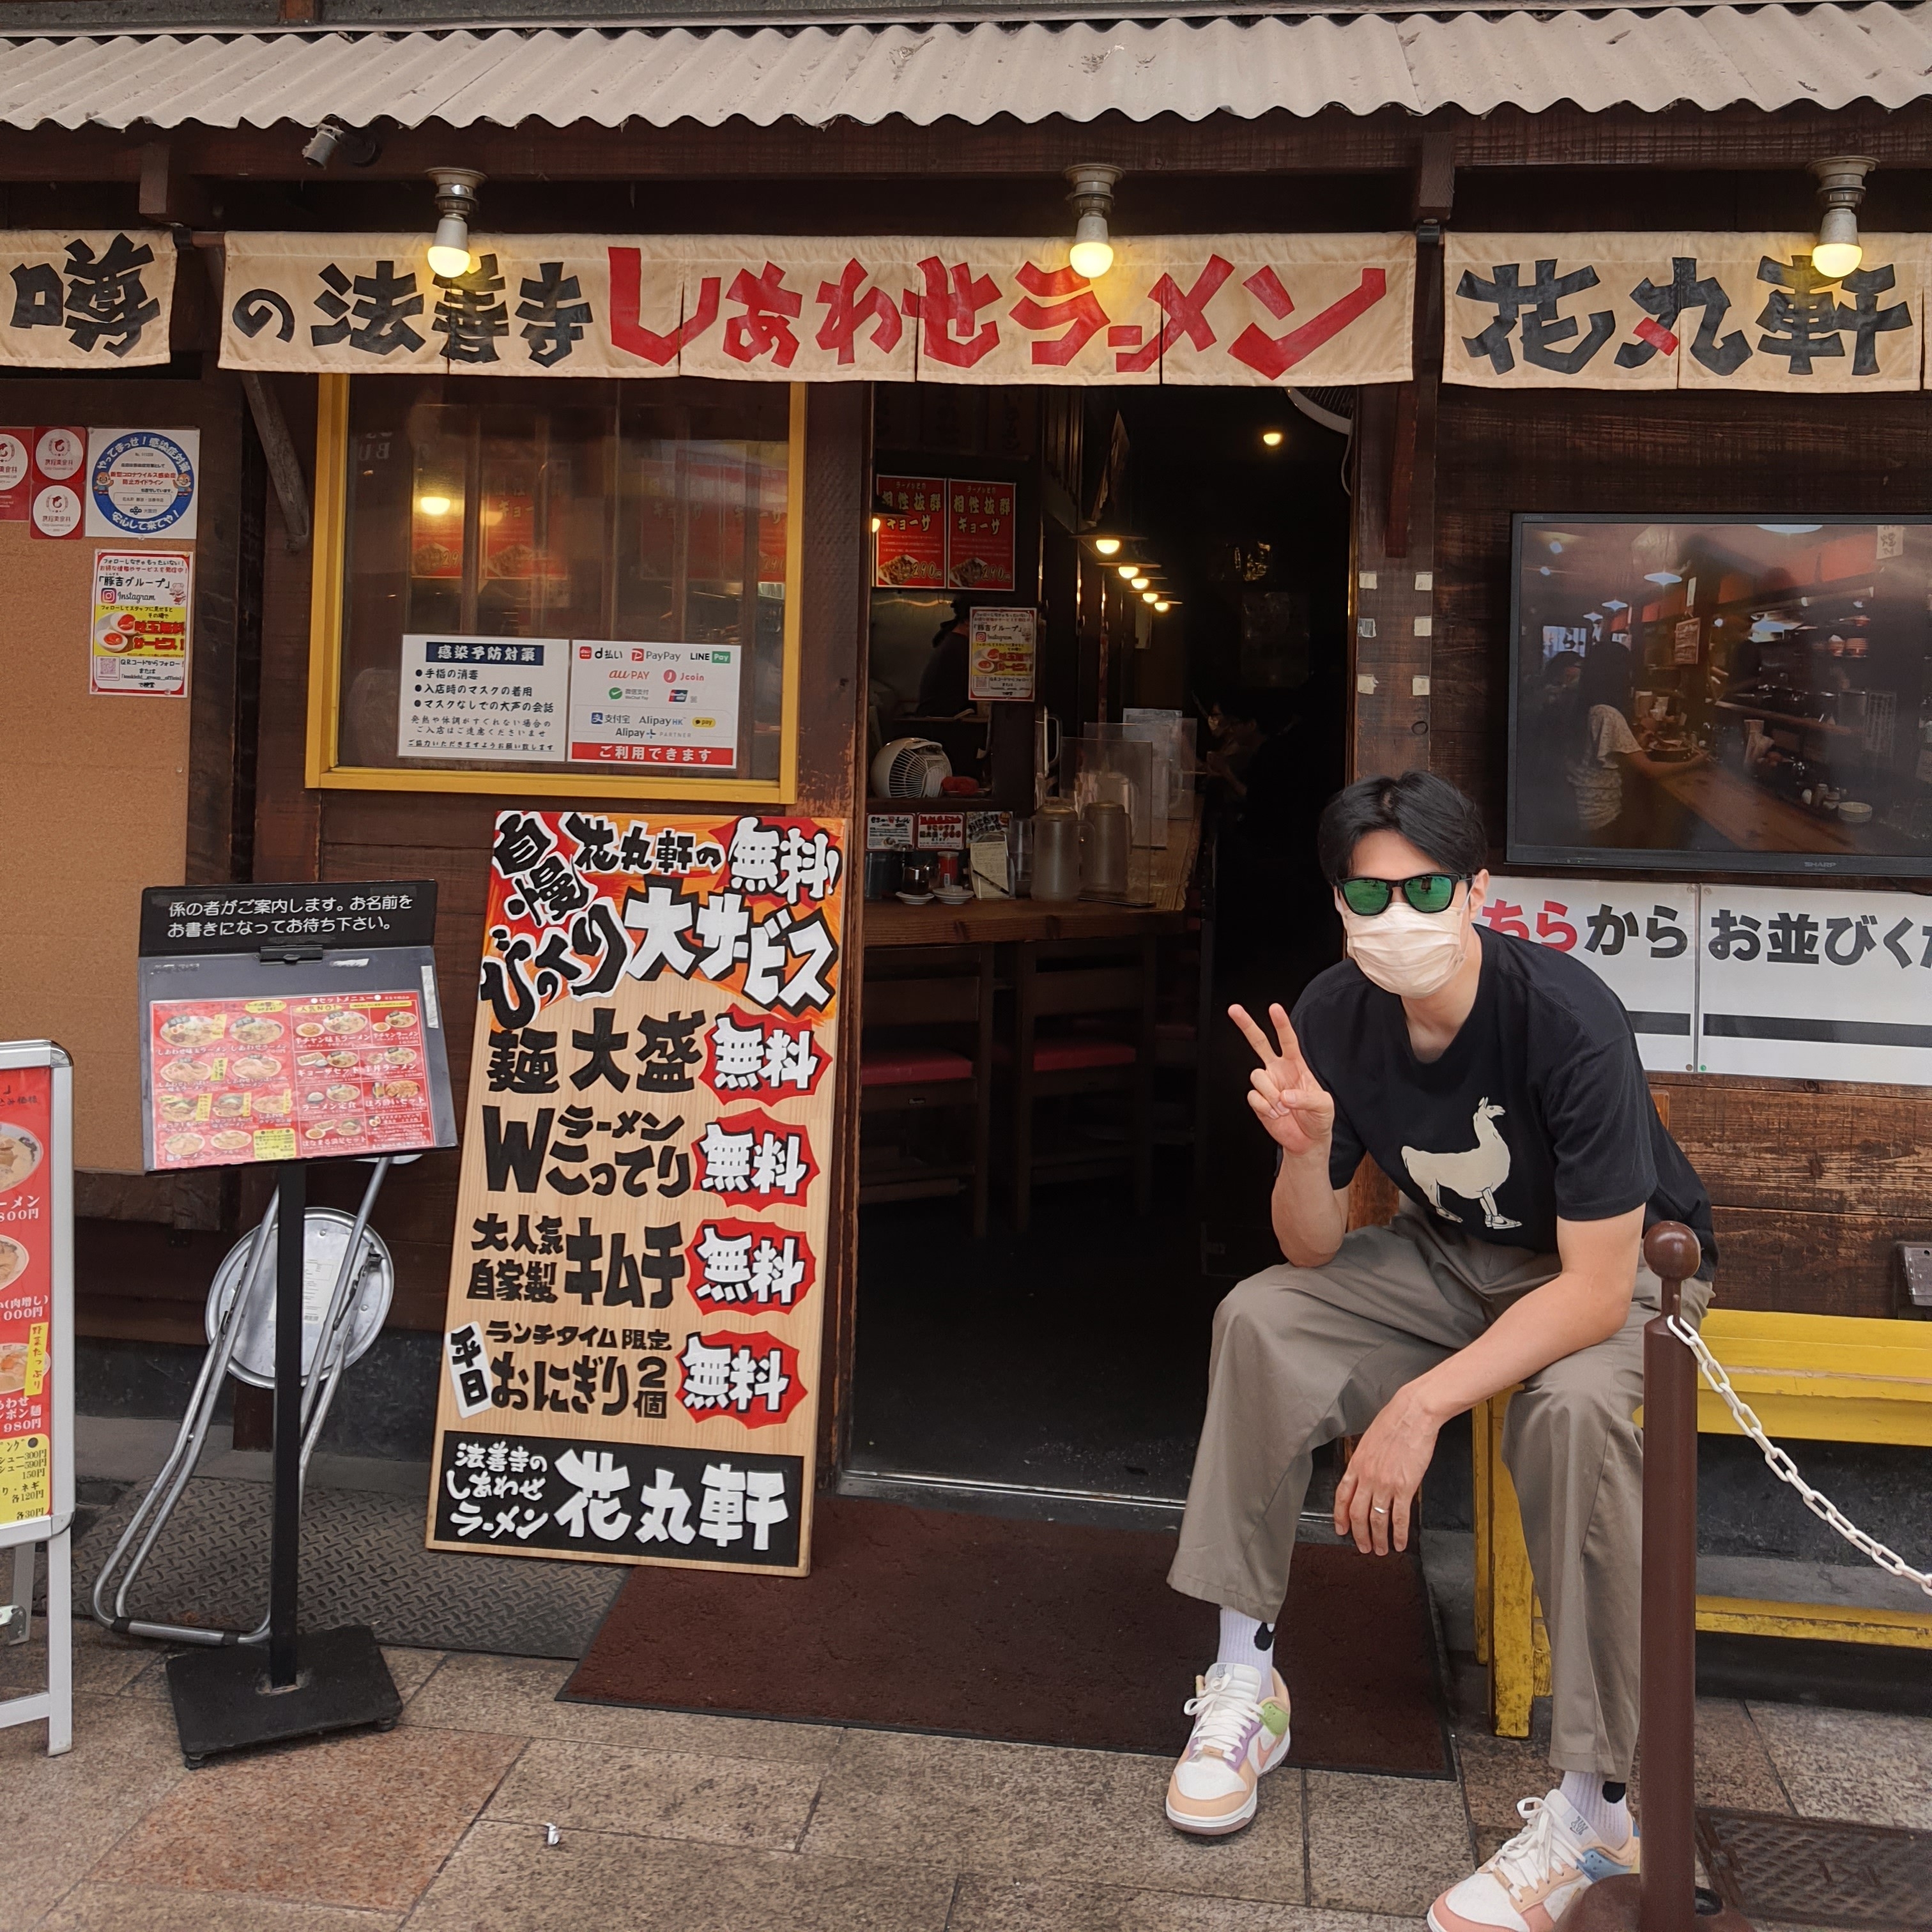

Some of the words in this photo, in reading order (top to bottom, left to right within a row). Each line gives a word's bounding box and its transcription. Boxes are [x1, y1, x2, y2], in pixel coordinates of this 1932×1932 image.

[10, 233, 160, 358] 噂
[1455, 255, 1913, 376] 花丸軒
[118, 591, 156, 603] Instagram
[437, 644, 535, 662] 感染予防対策
[646, 651, 681, 662] PayPay
[714, 654, 729, 662] Pay
[424, 684, 533, 697] 入店時のマスクの着用
[425, 668, 479, 680] 手指の消毒
[609, 670, 629, 678] au
[631, 671, 650, 679] PAY
[680, 673, 705, 681] Jcoin
[424, 699, 554, 714] マスクなしでの大声の会話
[604, 714, 631, 724] 支付宝
[599, 745, 712, 762] ご利用できます
[562, 812, 723, 874] 花丸軒の
[493, 811, 590, 926] 自慢
[169, 894, 413, 917] 係の者がご案内します。お名前を
[167, 917, 391, 939] お書きになってお待ち下さい。
[1708, 909, 1932, 969] お並びく
[480, 898, 631, 1031] びっくり
[486, 1008, 707, 1094] 麺大盛
[710, 1014, 818, 1090] 無料
[557, 1103, 685, 1142] ラーメン
[482, 1105, 556, 1193] W
[699, 1122, 811, 1197] 無料
[546, 1140, 691, 1199] こってり
[470, 1213, 565, 1255] 大人気
[467, 1259, 558, 1304] 自家製
[564, 1216, 686, 1308] キムチ
[694, 1225, 808, 1305] 無料
[486, 1320, 672, 1352] ランチタイム限定
[32, 1326, 42, 1390] 野菜たっぷり
[449, 1324, 489, 1410] 平日
[681, 1331, 792, 1416] 無料
[490, 1351, 630, 1418] おにぎり
[4, 1418, 42, 1433] 980円
[22, 1468, 45, 1480] 150円
[454, 1441, 548, 1473] 法善寺の
[12, 1489, 44, 1503] 各120円
[446, 1469, 547, 1501] しあわせ
[553, 1448, 789, 1551] 花丸軒
[17, 1507, 44, 1521] 各30円
[450, 1501, 549, 1540] ラーメン
